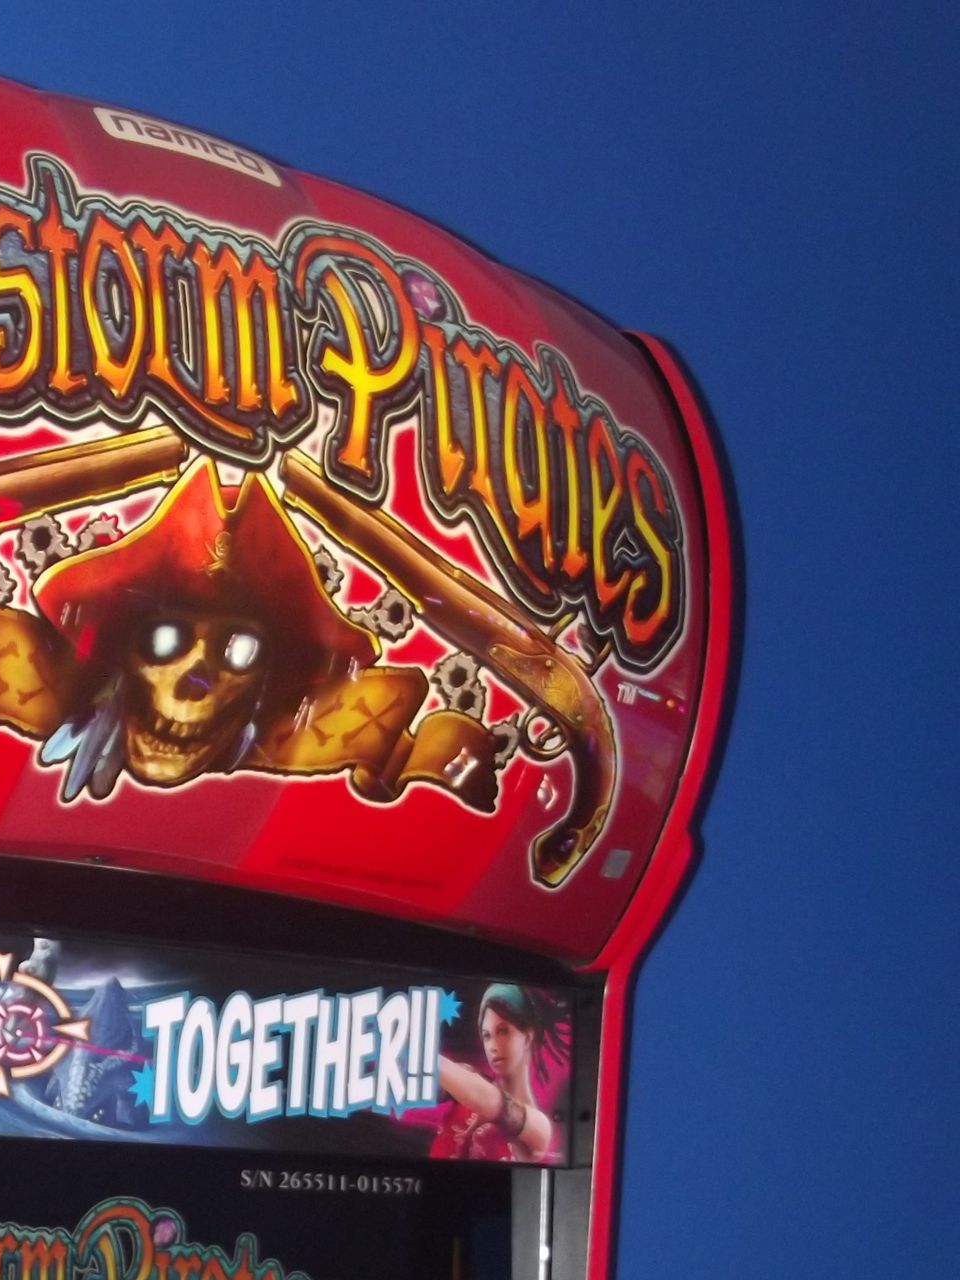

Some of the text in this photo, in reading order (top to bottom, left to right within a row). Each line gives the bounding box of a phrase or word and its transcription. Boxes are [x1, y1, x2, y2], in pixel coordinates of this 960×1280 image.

[109, 113, 266, 176] namco
[286, 227, 677, 650] Pirates
[147, 987, 437, 1121] TOGETHER!!
[240, 1169, 273, 1188] S/N
